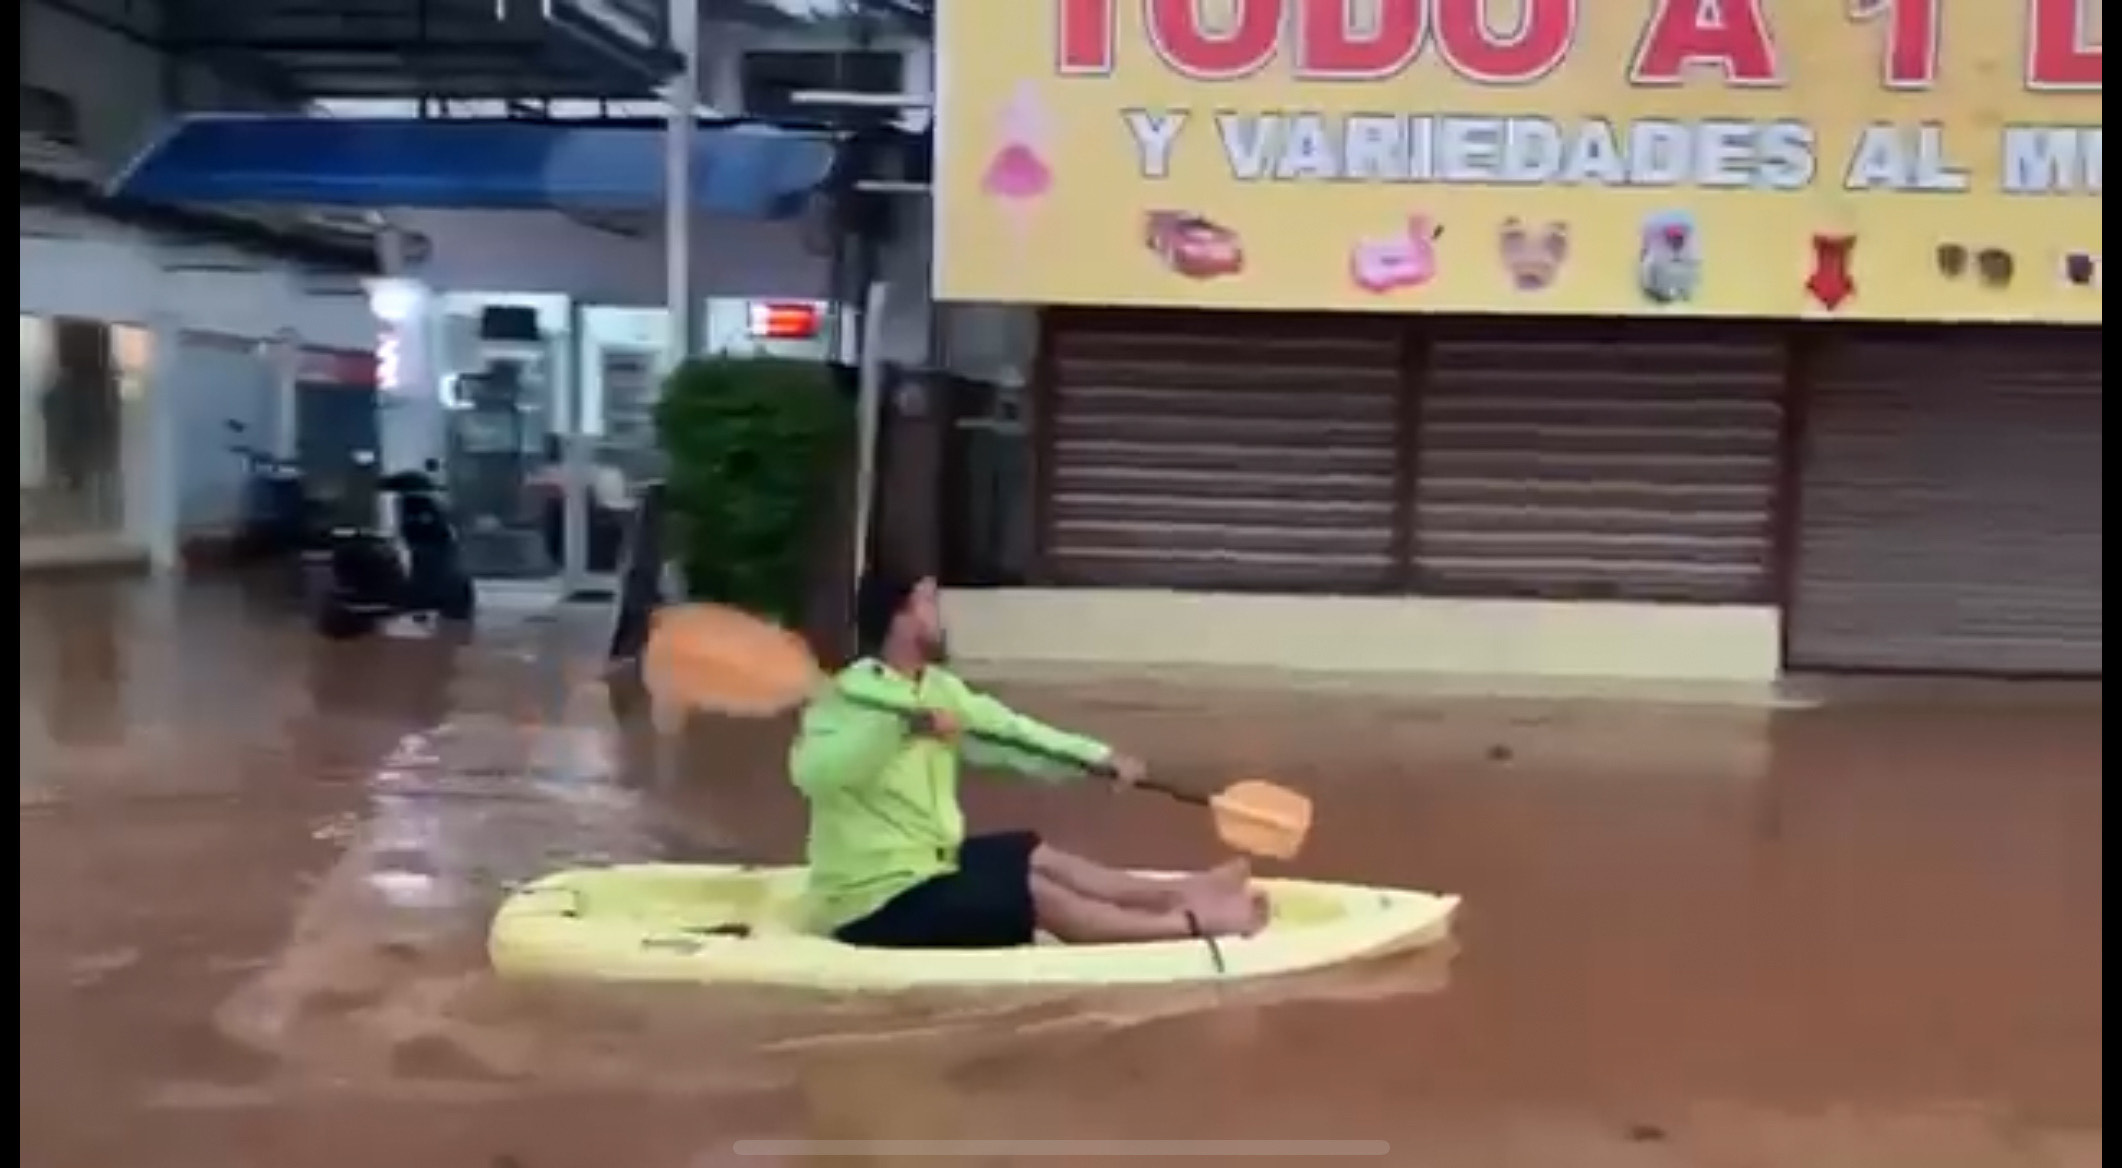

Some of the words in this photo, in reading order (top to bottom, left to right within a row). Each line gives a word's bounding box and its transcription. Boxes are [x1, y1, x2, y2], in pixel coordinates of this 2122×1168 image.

[1122, 109, 1189, 178] Y
[1214, 109, 1816, 190] VARIEDADES
[1844, 121, 1972, 192] AL
